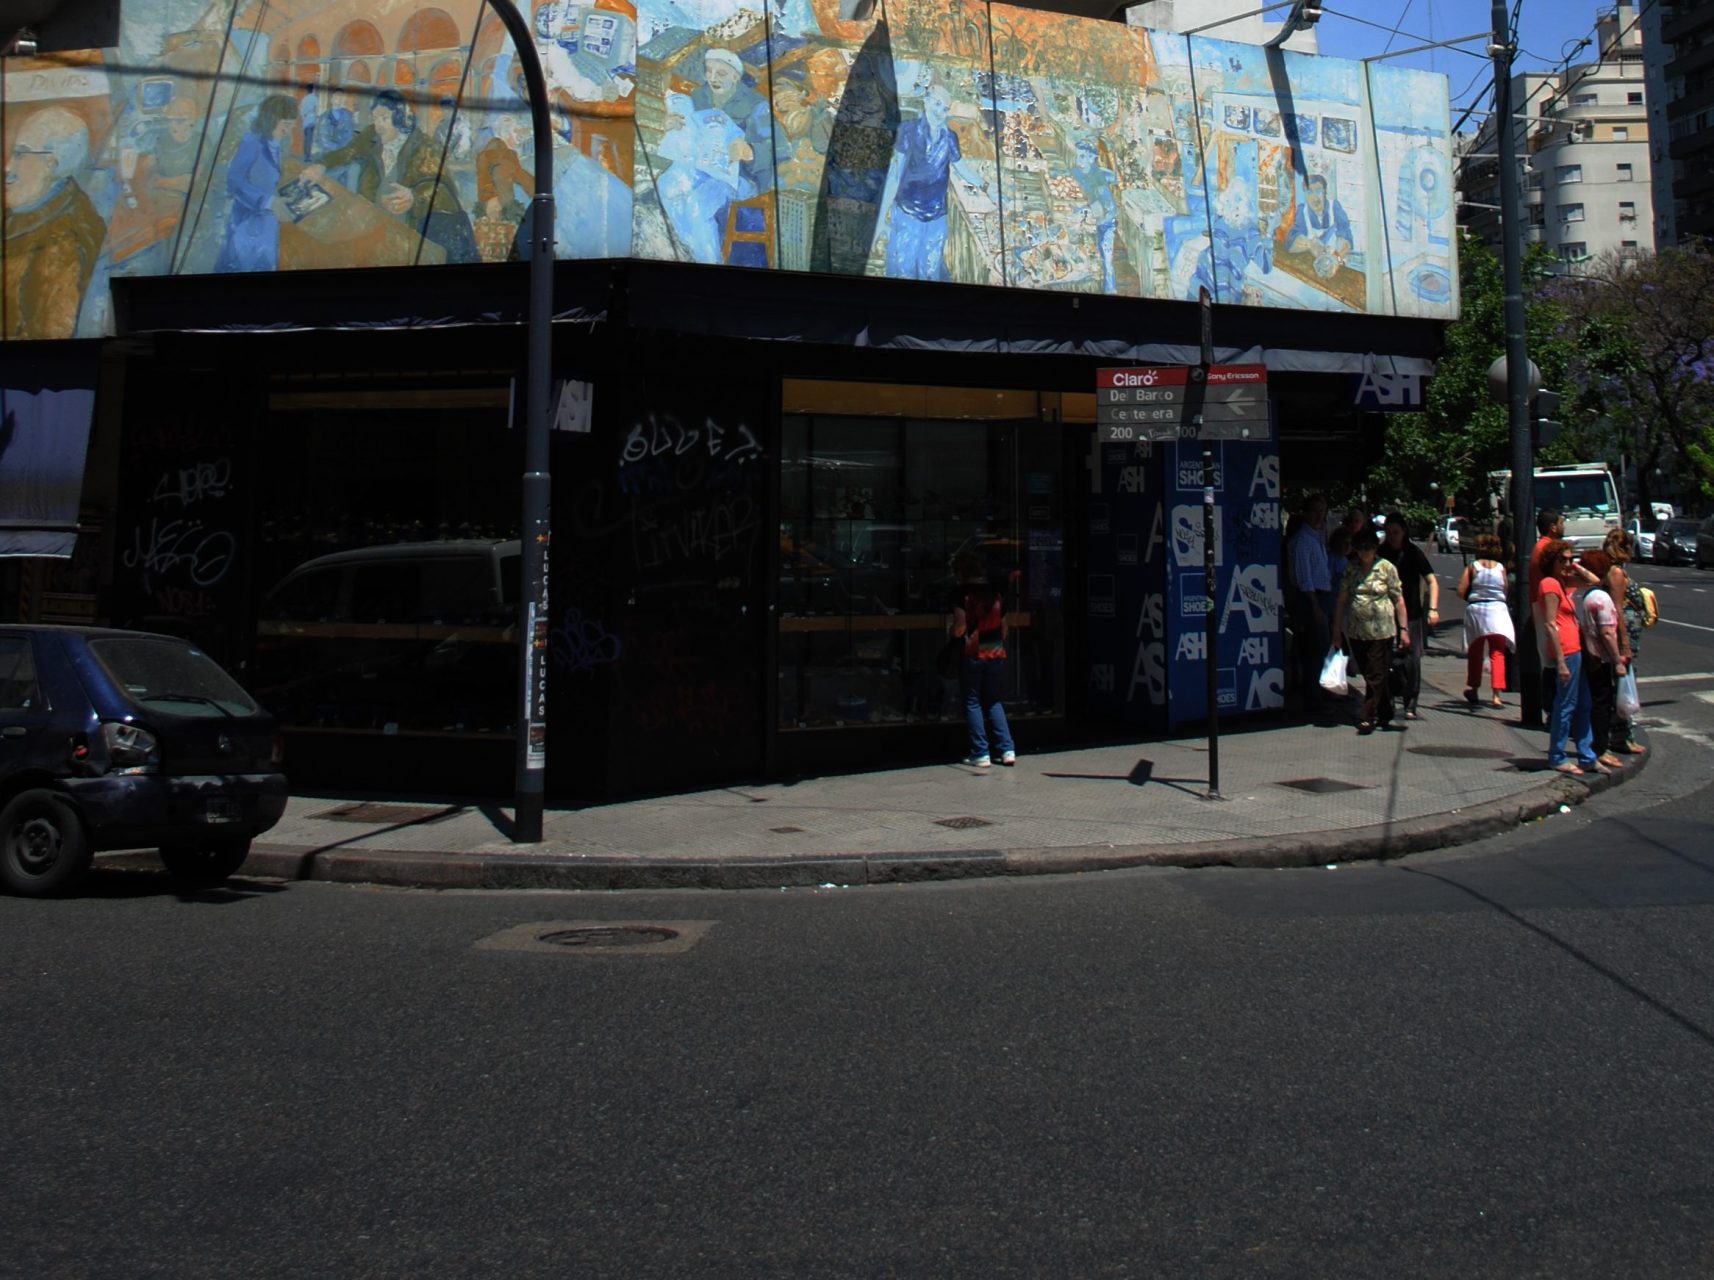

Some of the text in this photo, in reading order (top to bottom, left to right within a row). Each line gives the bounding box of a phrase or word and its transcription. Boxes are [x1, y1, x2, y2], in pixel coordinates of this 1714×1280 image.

[1112, 372, 1155, 387] Claro
[1227, 372, 1260, 380] Ericsson
[1353, 371, 1421, 406] ASH
[1111, 408, 1174, 420] Ceteera
[1109, 426, 1133, 439] 200
[1176, 426, 1197, 439] 100
[1116, 465, 1145, 493] ASH
[1179, 470, 1221, 486] SHOS
[1182, 600, 1214, 614] SHOE
[1175, 631, 1208, 661] ASH
[1237, 636, 1269, 666] ASH
[537, 655, 547, 717] LUCAS
